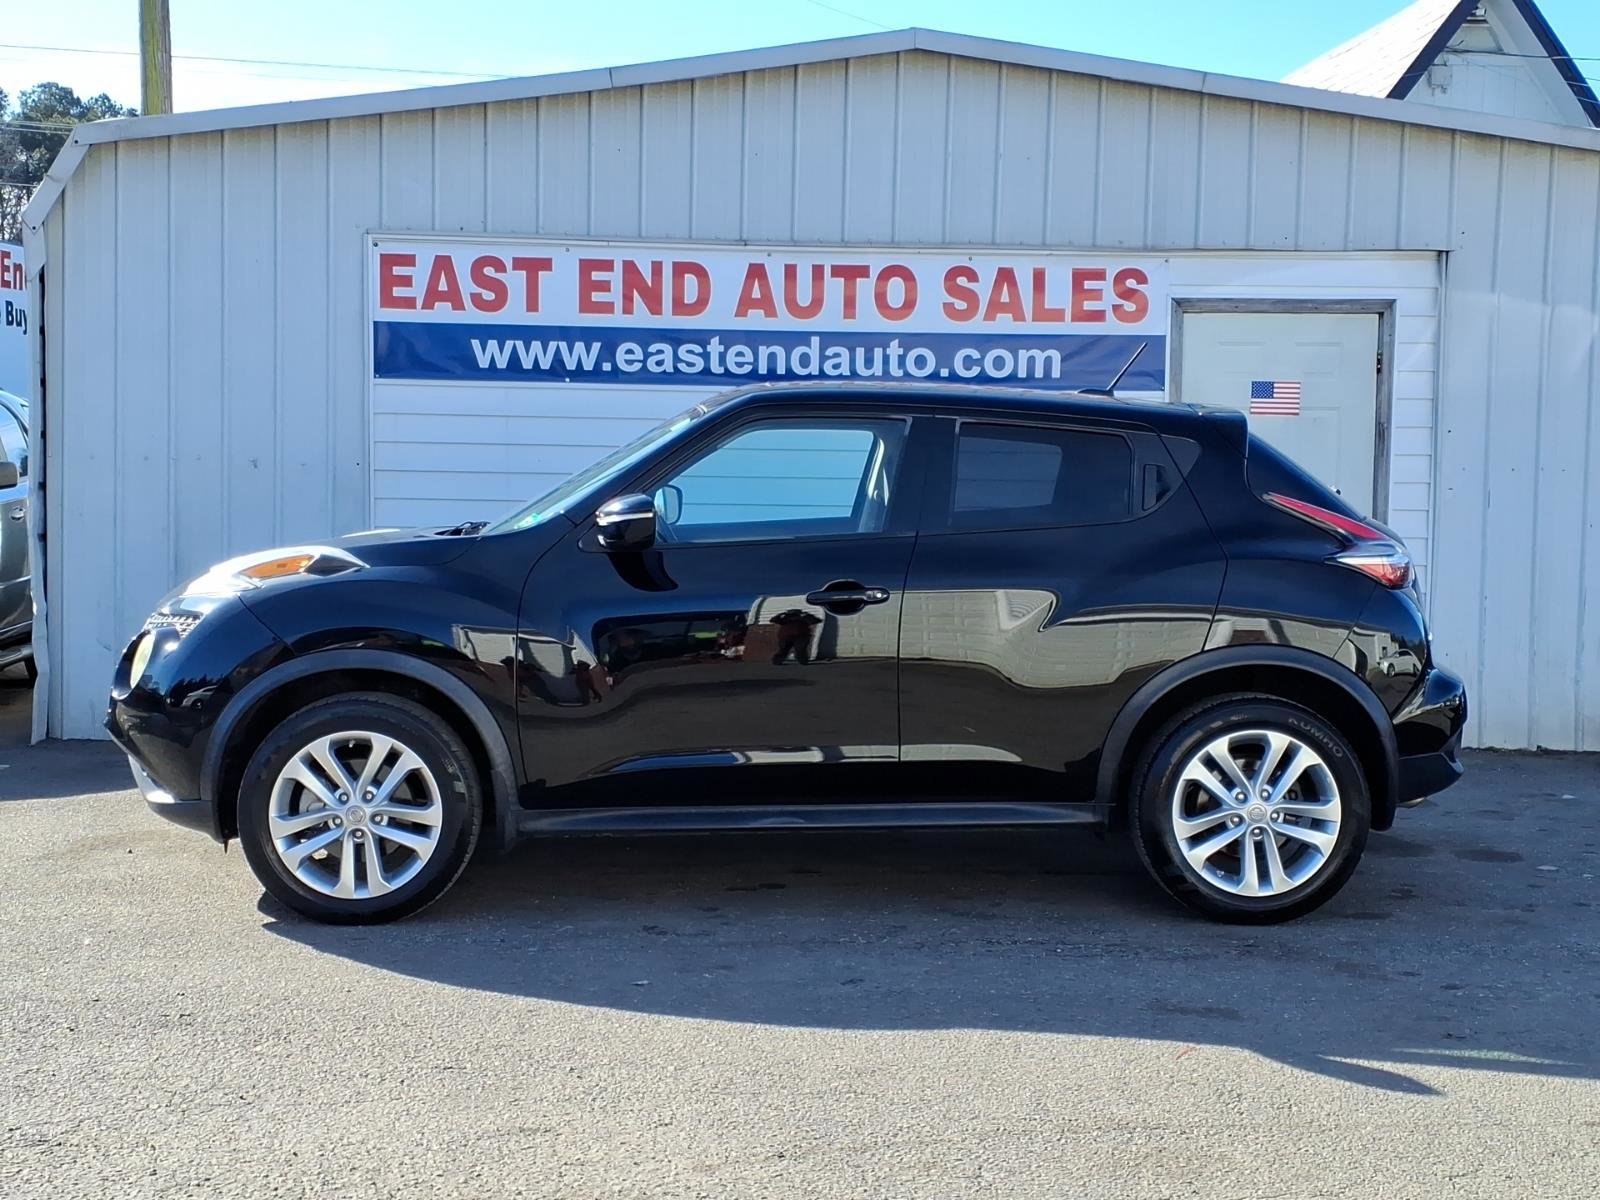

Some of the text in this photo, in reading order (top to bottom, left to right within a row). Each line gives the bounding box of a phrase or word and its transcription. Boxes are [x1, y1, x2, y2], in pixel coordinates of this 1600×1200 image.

[0, 250, 27, 290] En
[380, 253, 1149, 324] EAST END AUTO SALES
[5, 300, 27, 335] Buy
[470, 335, 1062, 379] www.eastendauto.com
